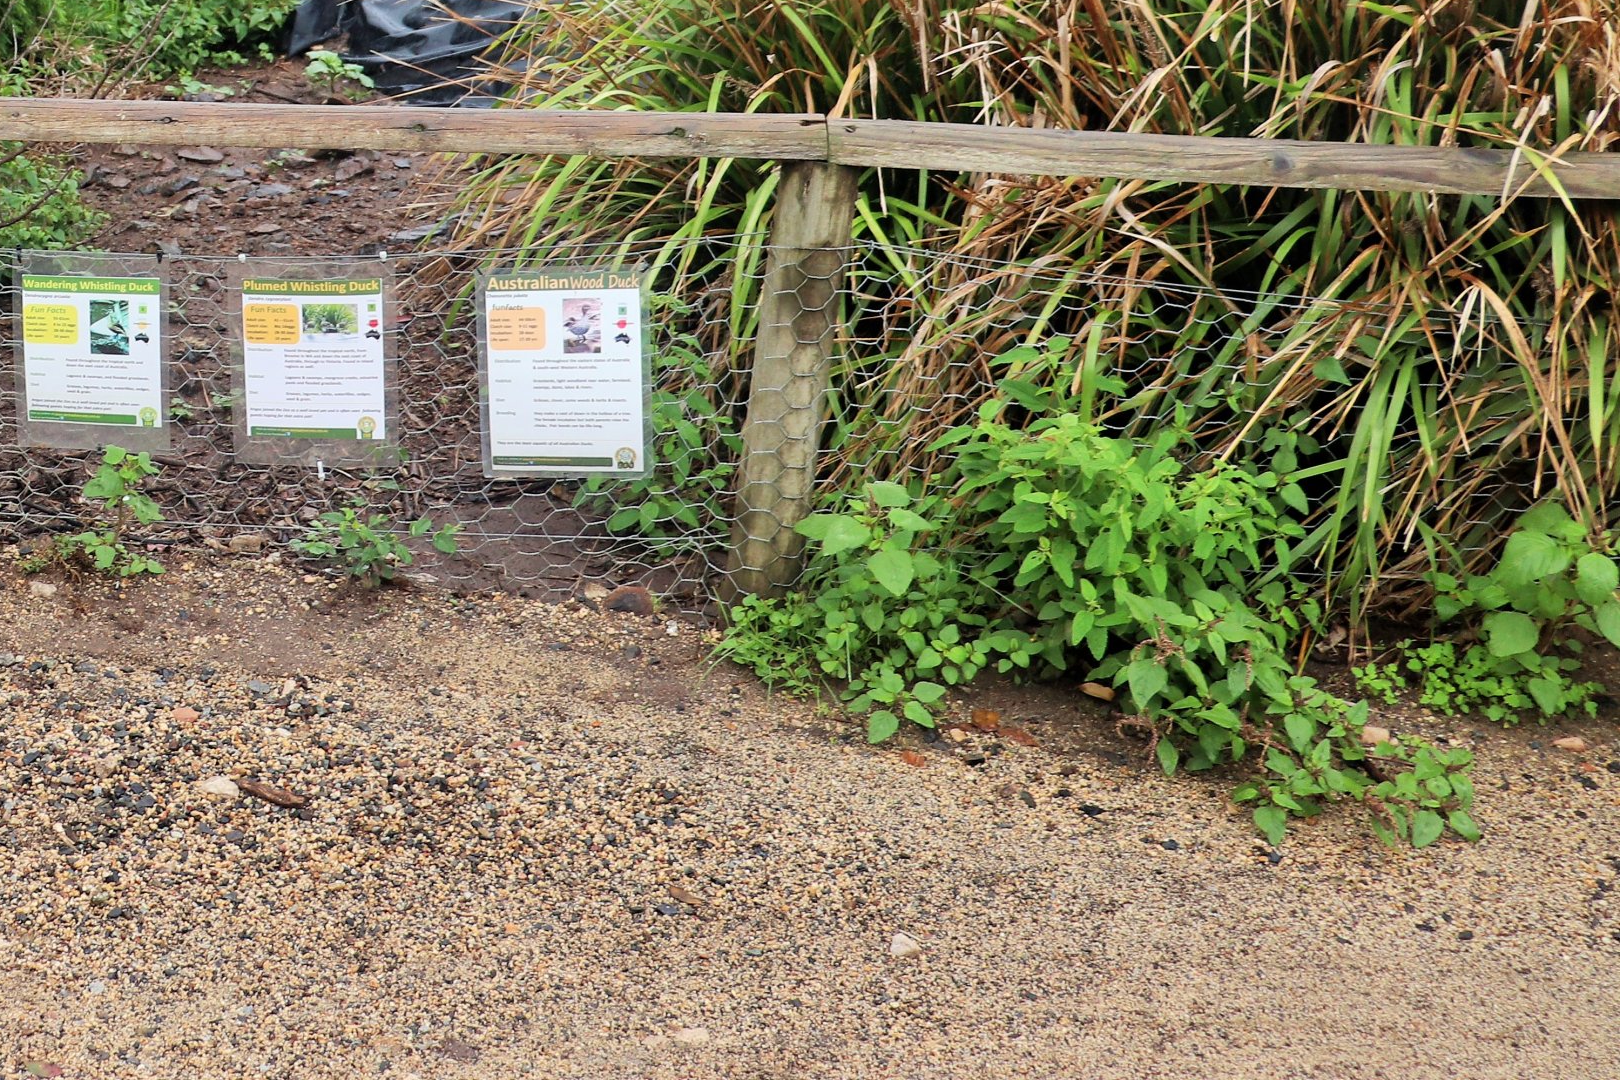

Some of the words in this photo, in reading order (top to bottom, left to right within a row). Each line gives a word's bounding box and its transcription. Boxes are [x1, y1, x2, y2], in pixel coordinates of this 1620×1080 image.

[23, 279, 78, 291] Wandering
[80, 280, 127, 292] Whistling
[129, 282, 154, 291] Duck
[243, 281, 287, 291] Plumed
[290, 281, 347, 294] Whistling
[349, 280, 378, 291] Duck
[487, 276, 569, 291] Australian
[570, 274, 605, 289] Wood
[608, 274, 640, 289] Duck
[46, 306, 66, 314] Facts
[267, 306, 286, 314] Facts
